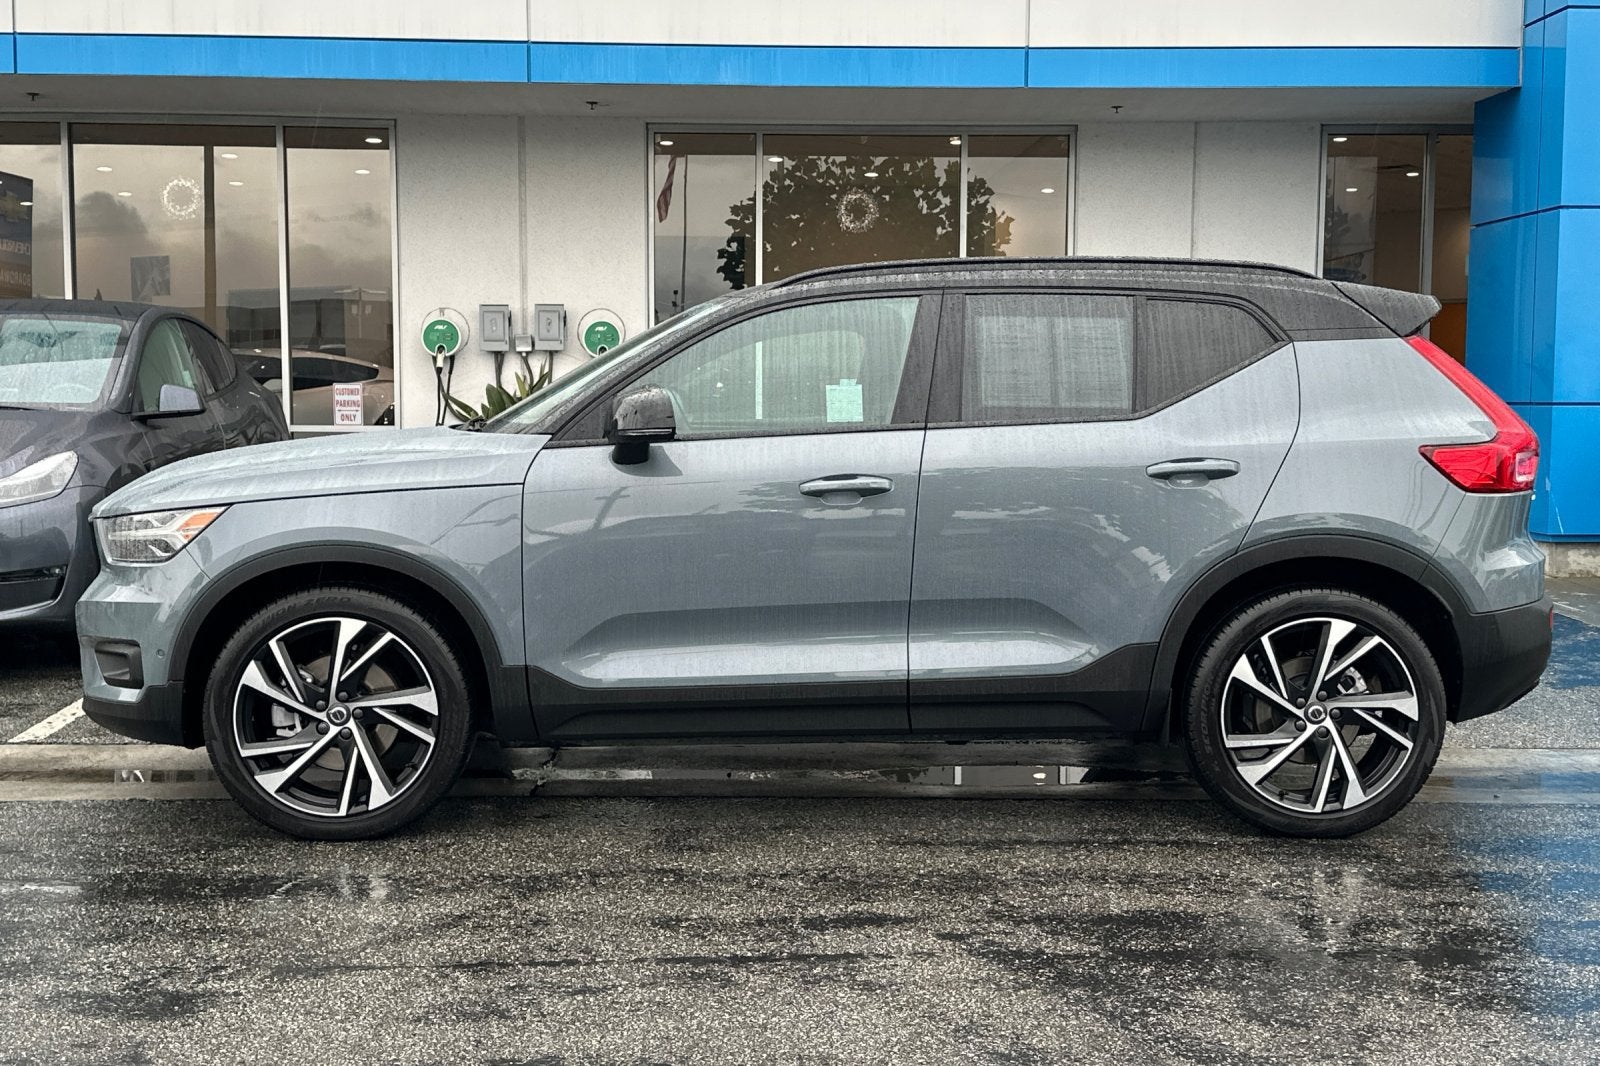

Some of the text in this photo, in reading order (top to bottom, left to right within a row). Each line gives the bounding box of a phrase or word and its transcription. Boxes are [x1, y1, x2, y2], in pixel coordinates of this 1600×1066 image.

[335, 388, 359, 396] CUSTOMER
[336, 400, 360, 408] PARKING
[340, 413, 356, 422] ONLY
